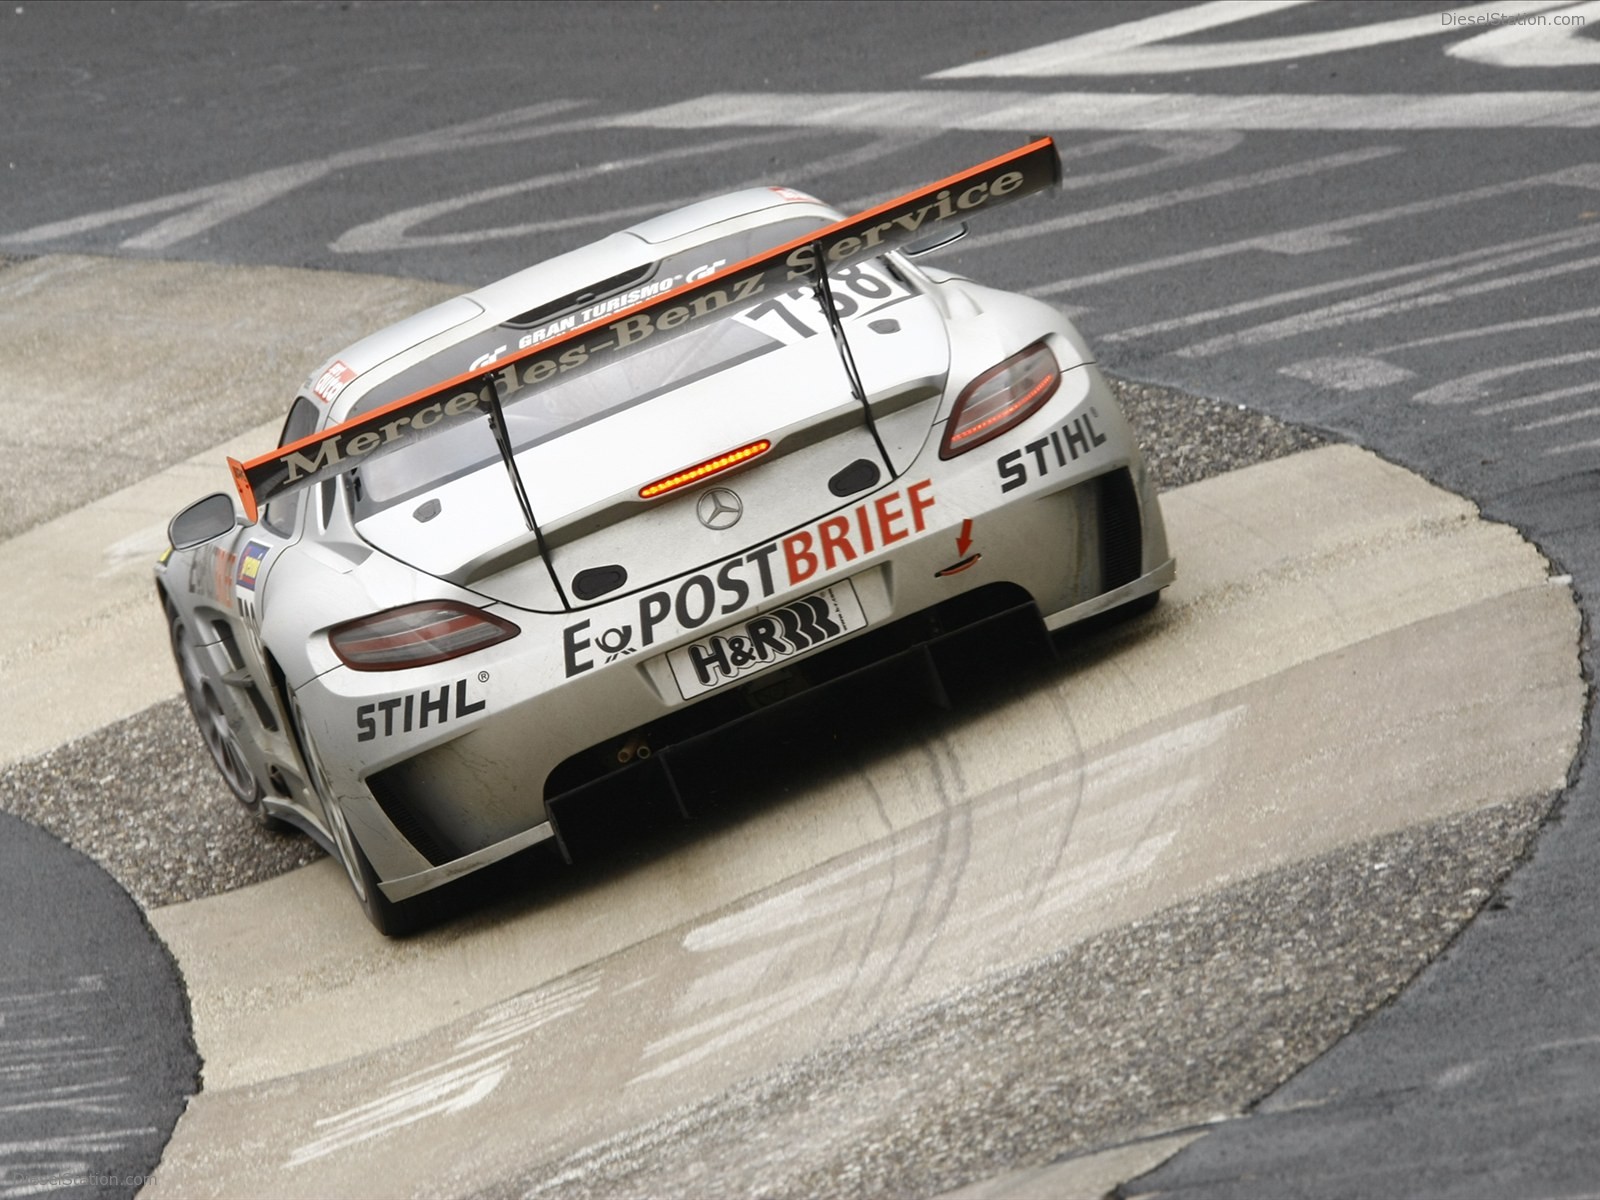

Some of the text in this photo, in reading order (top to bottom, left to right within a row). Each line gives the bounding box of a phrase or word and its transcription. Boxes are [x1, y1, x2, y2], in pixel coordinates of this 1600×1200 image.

[280, 171, 1025, 485] Mercedes-Benz Service
[518, 316, 576, 350] GRAN
[581, 277, 674, 322] TURISMO
[996, 413, 1108, 494] STIHL
